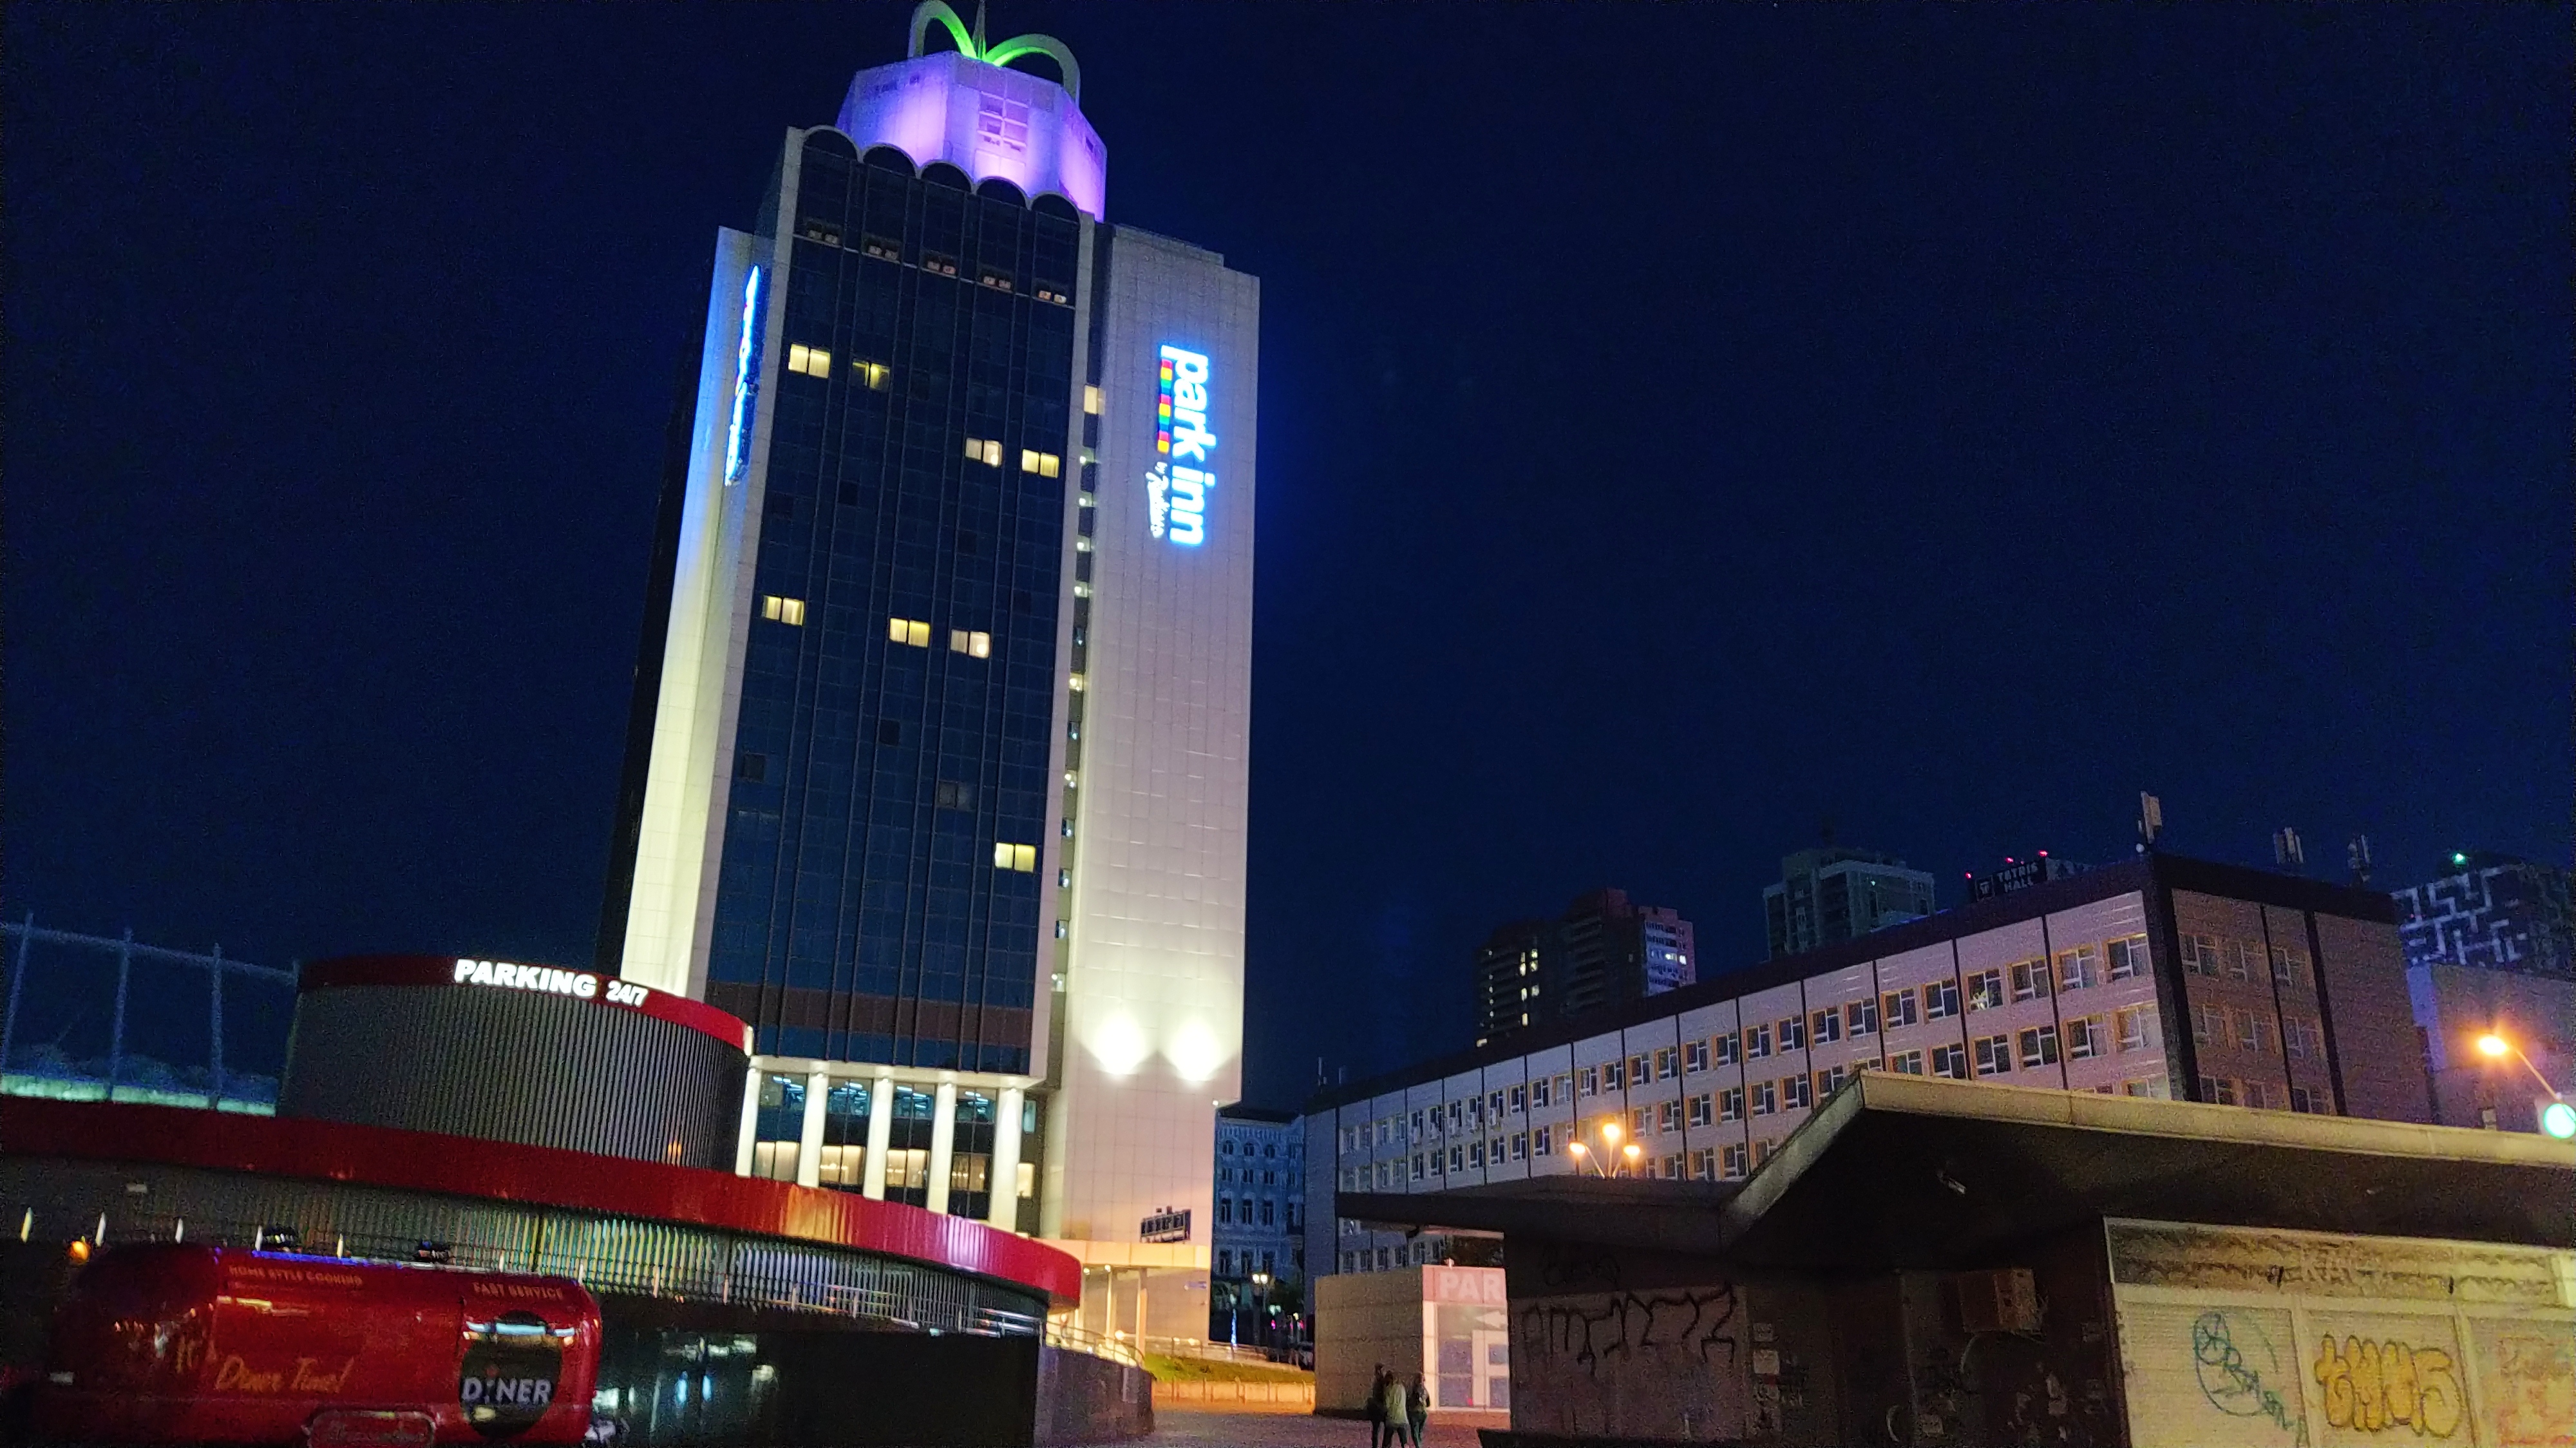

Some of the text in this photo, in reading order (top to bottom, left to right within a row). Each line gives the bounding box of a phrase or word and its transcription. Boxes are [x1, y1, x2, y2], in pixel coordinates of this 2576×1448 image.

[1160, 345, 1217, 545] park inn
[2004, 876, 2034, 893] HALL
[454, 959, 597, 998] PARKING
[305, 1271, 363, 1286] COOKING
[472, 1281, 504, 1297] FAST
